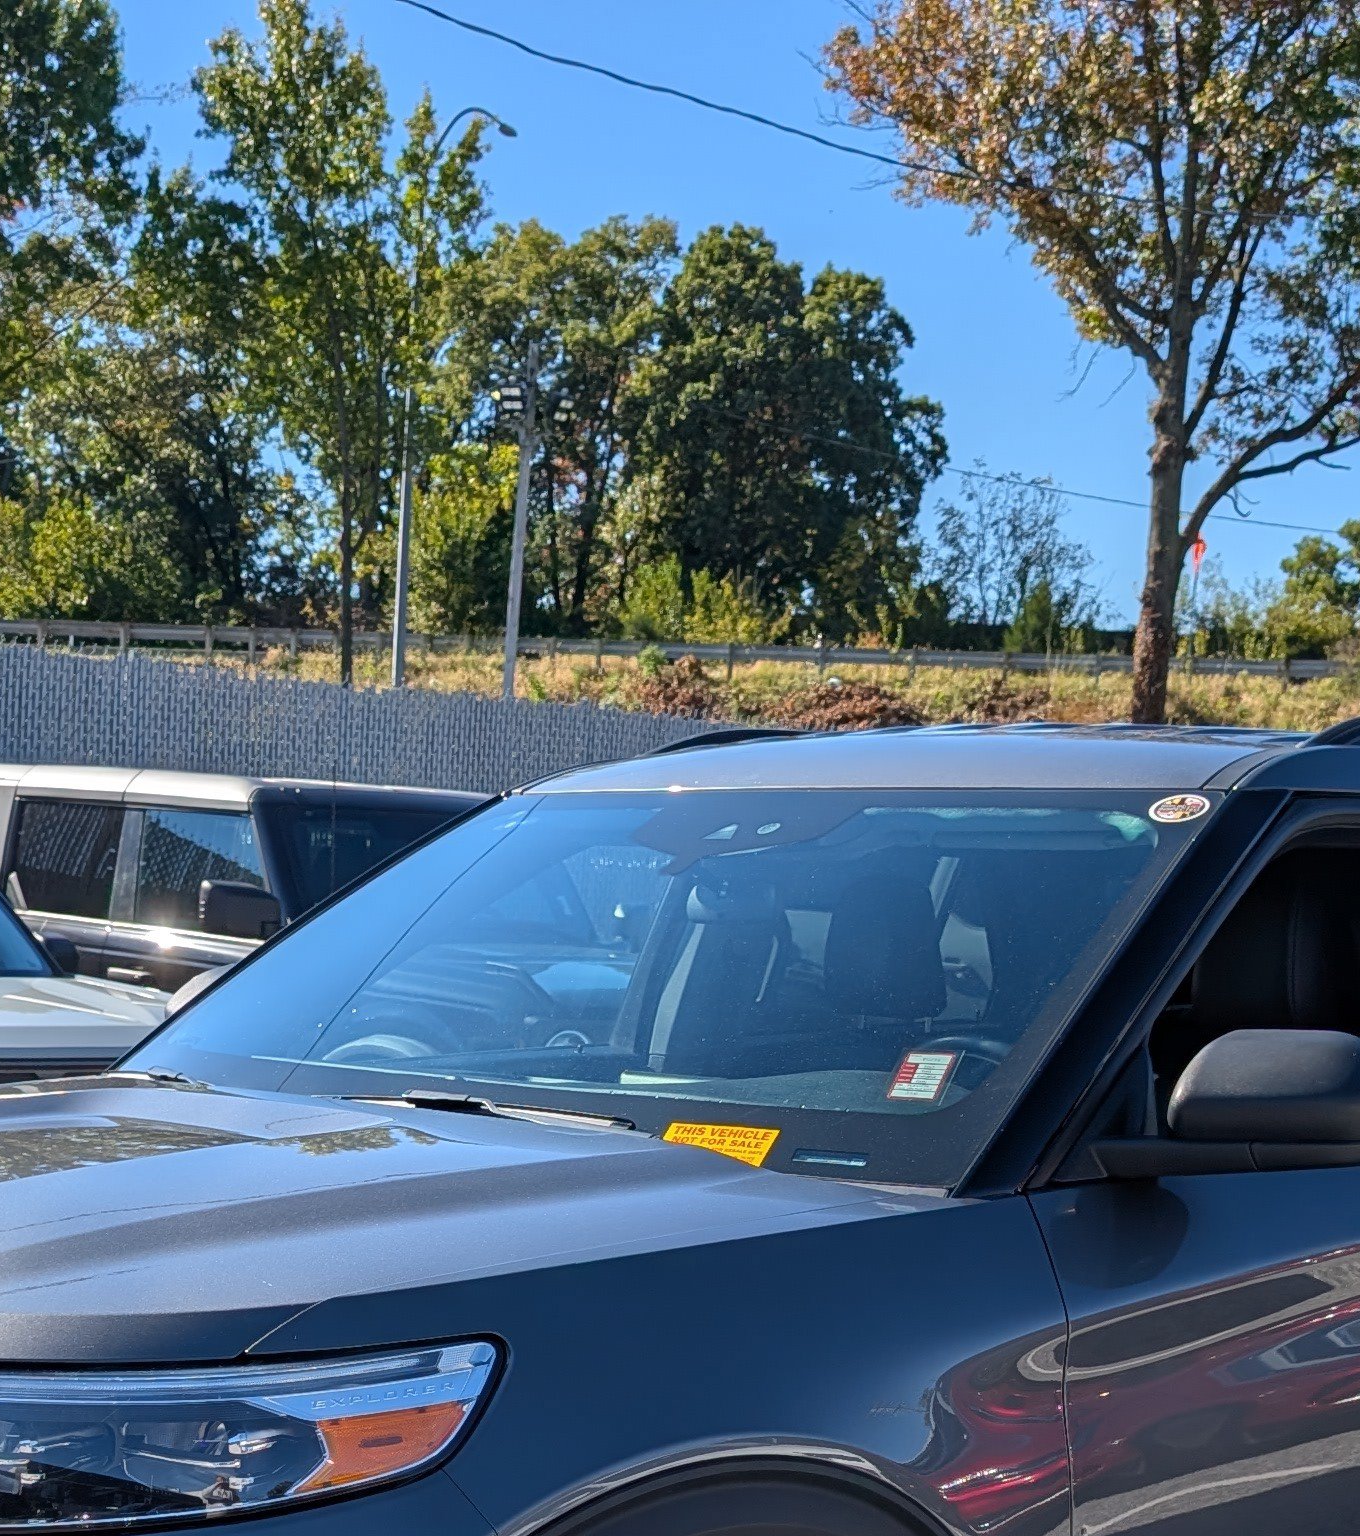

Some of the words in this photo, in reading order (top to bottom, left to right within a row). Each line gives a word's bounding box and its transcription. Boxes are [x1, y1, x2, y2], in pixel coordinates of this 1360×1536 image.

[674, 1125, 706, 1136] THIS
[710, 1128, 773, 1141] VEHICLE
[672, 1136, 698, 1145] NOT
[700, 1137, 726, 1146] FOR
[729, 1139, 764, 1149] SALE
[311, 1382, 455, 1410] EXPLORER
